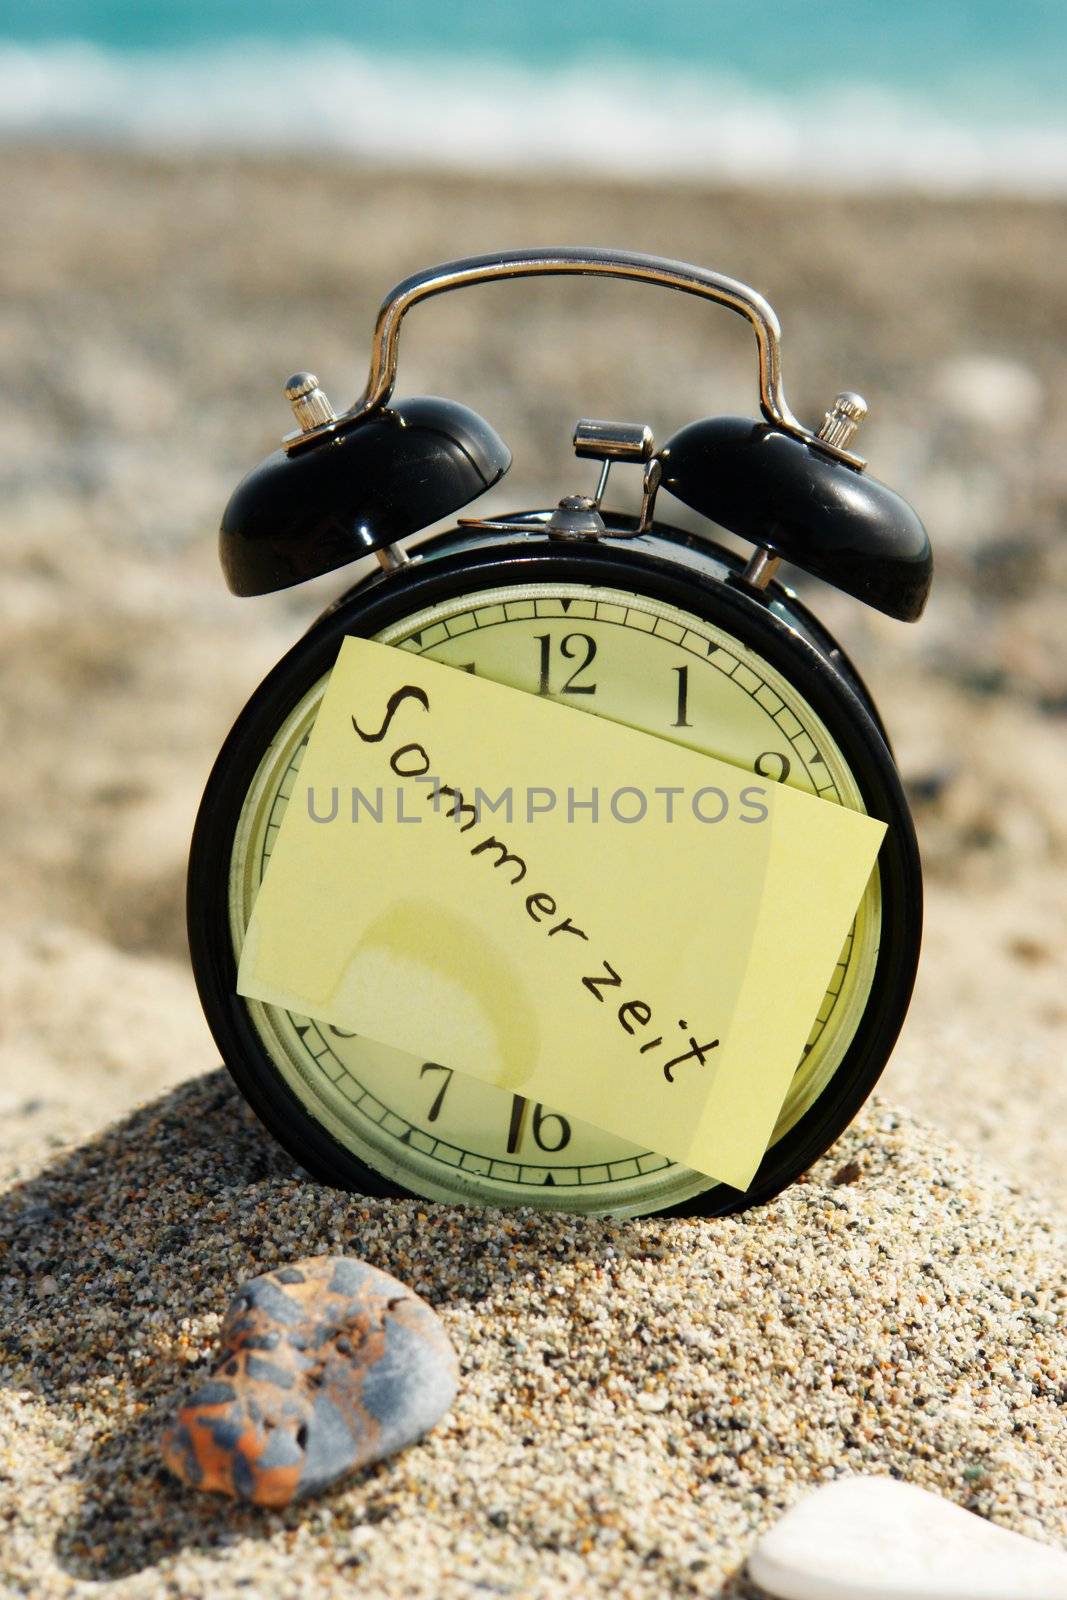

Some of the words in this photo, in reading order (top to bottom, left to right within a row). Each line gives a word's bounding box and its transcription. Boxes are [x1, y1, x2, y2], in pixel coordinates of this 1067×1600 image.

[533, 632, 598, 697] 12
[670, 665, 694, 727] 1
[351, 684, 720, 1083] Sommerzeit
[419, 1062, 455, 1122] 7
[532, 1102, 572, 1153] 6
